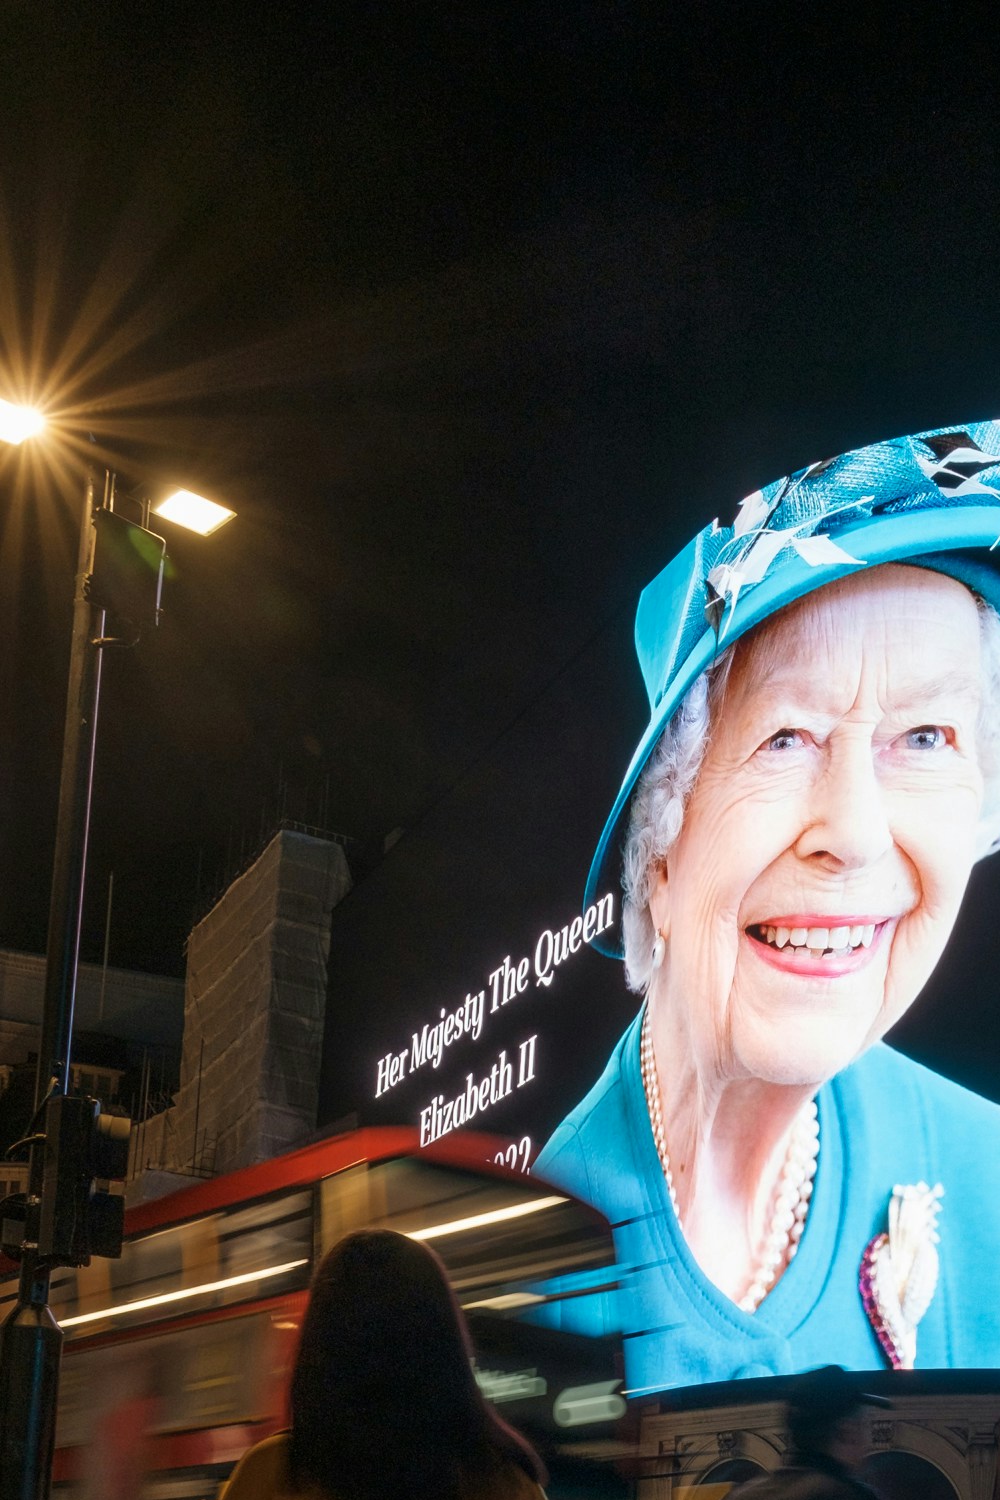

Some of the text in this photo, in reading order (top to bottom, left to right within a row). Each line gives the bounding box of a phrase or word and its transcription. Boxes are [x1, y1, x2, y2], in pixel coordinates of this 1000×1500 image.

[375, 892, 614, 1099] Her Majesty The Queen
[420, 1035, 538, 1148] Elizabeth II
